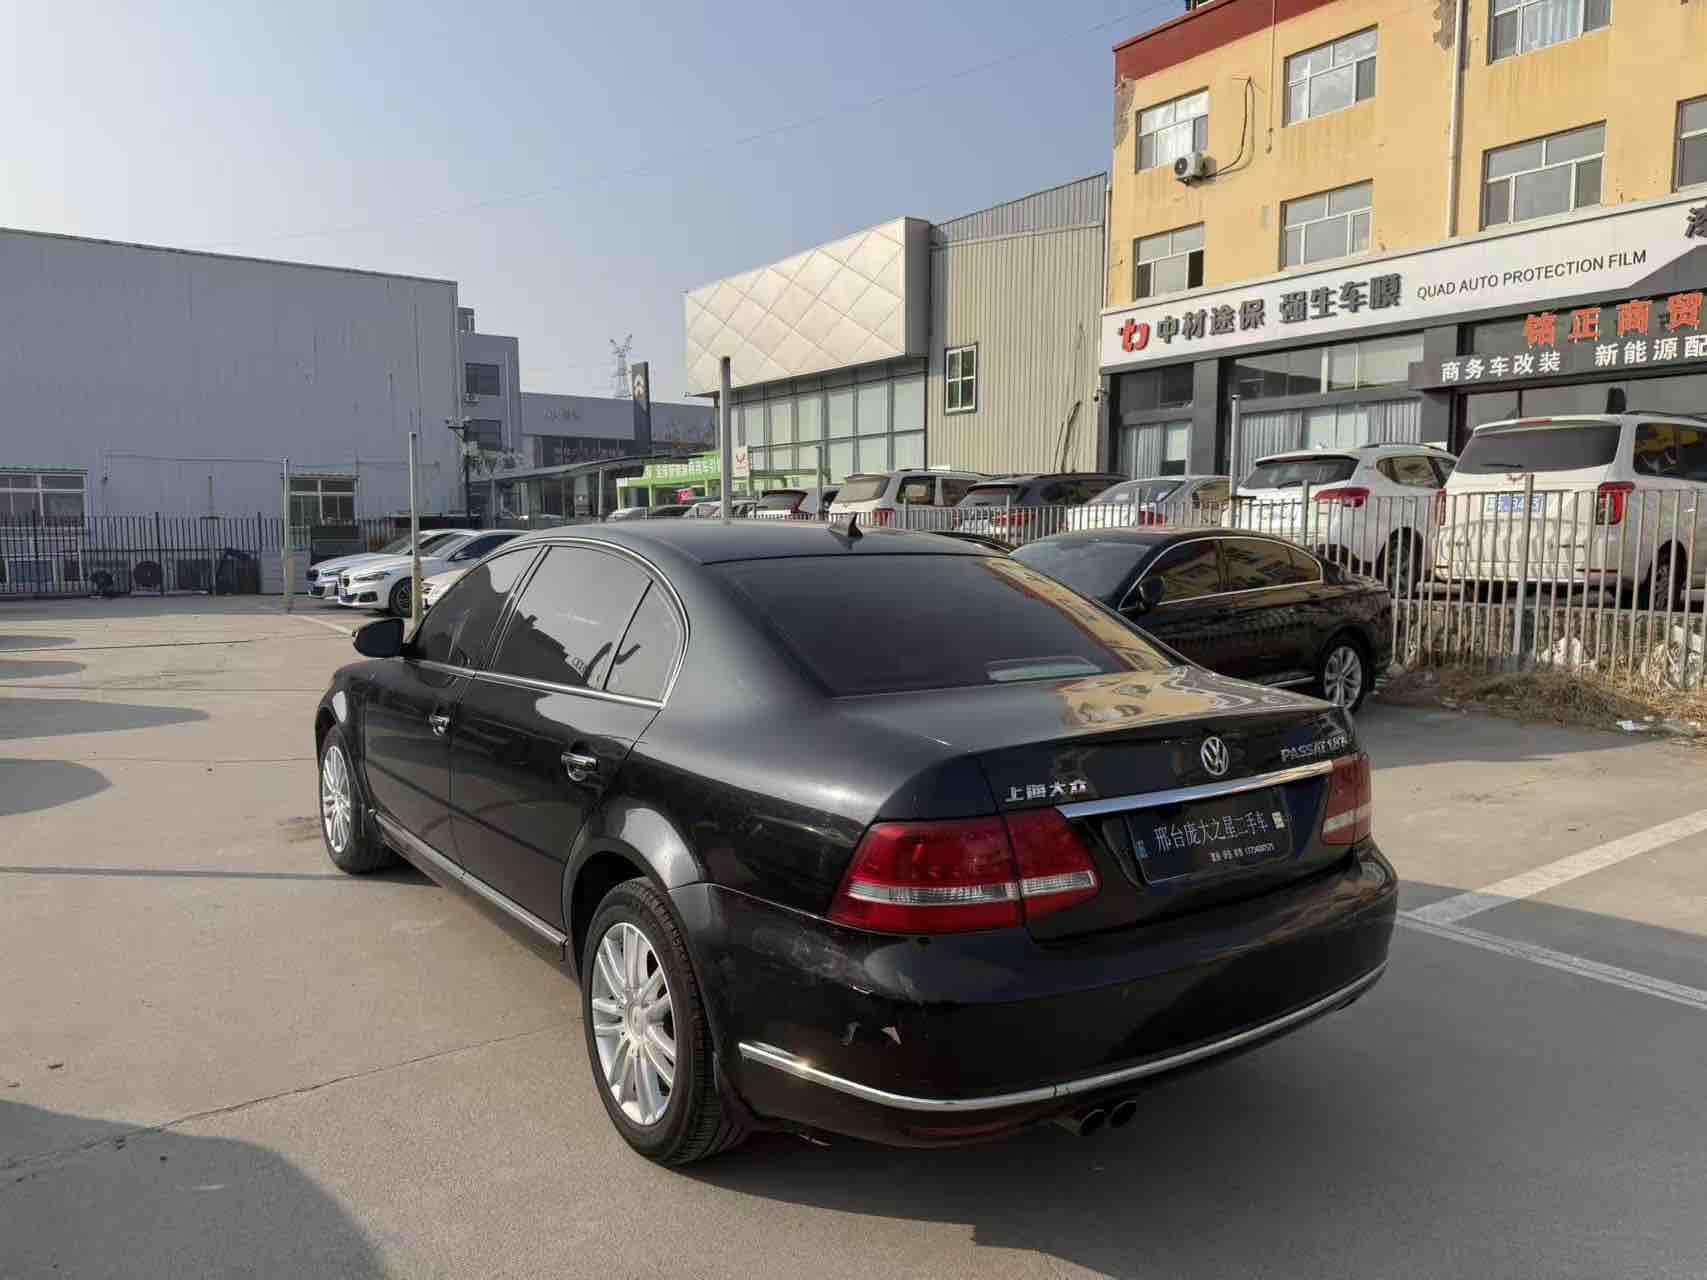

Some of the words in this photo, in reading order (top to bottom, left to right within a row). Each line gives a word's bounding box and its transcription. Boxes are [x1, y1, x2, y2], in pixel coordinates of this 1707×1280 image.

[1417, 281, 1456, 301] QUAD
[1459, 274, 1499, 292] AUTO
[1503, 254, 1604, 285] PROTECTION
[1608, 248, 1647, 269] FILM
[1157, 299, 1265, 344] 中材途保
[1279, 273, 1402, 324] 强生车膜
[1441, 351, 1561, 383] 商务车改装
[1594, 334, 1707, 367] 新能源配
[1004, 779, 1089, 802] 上海大众
